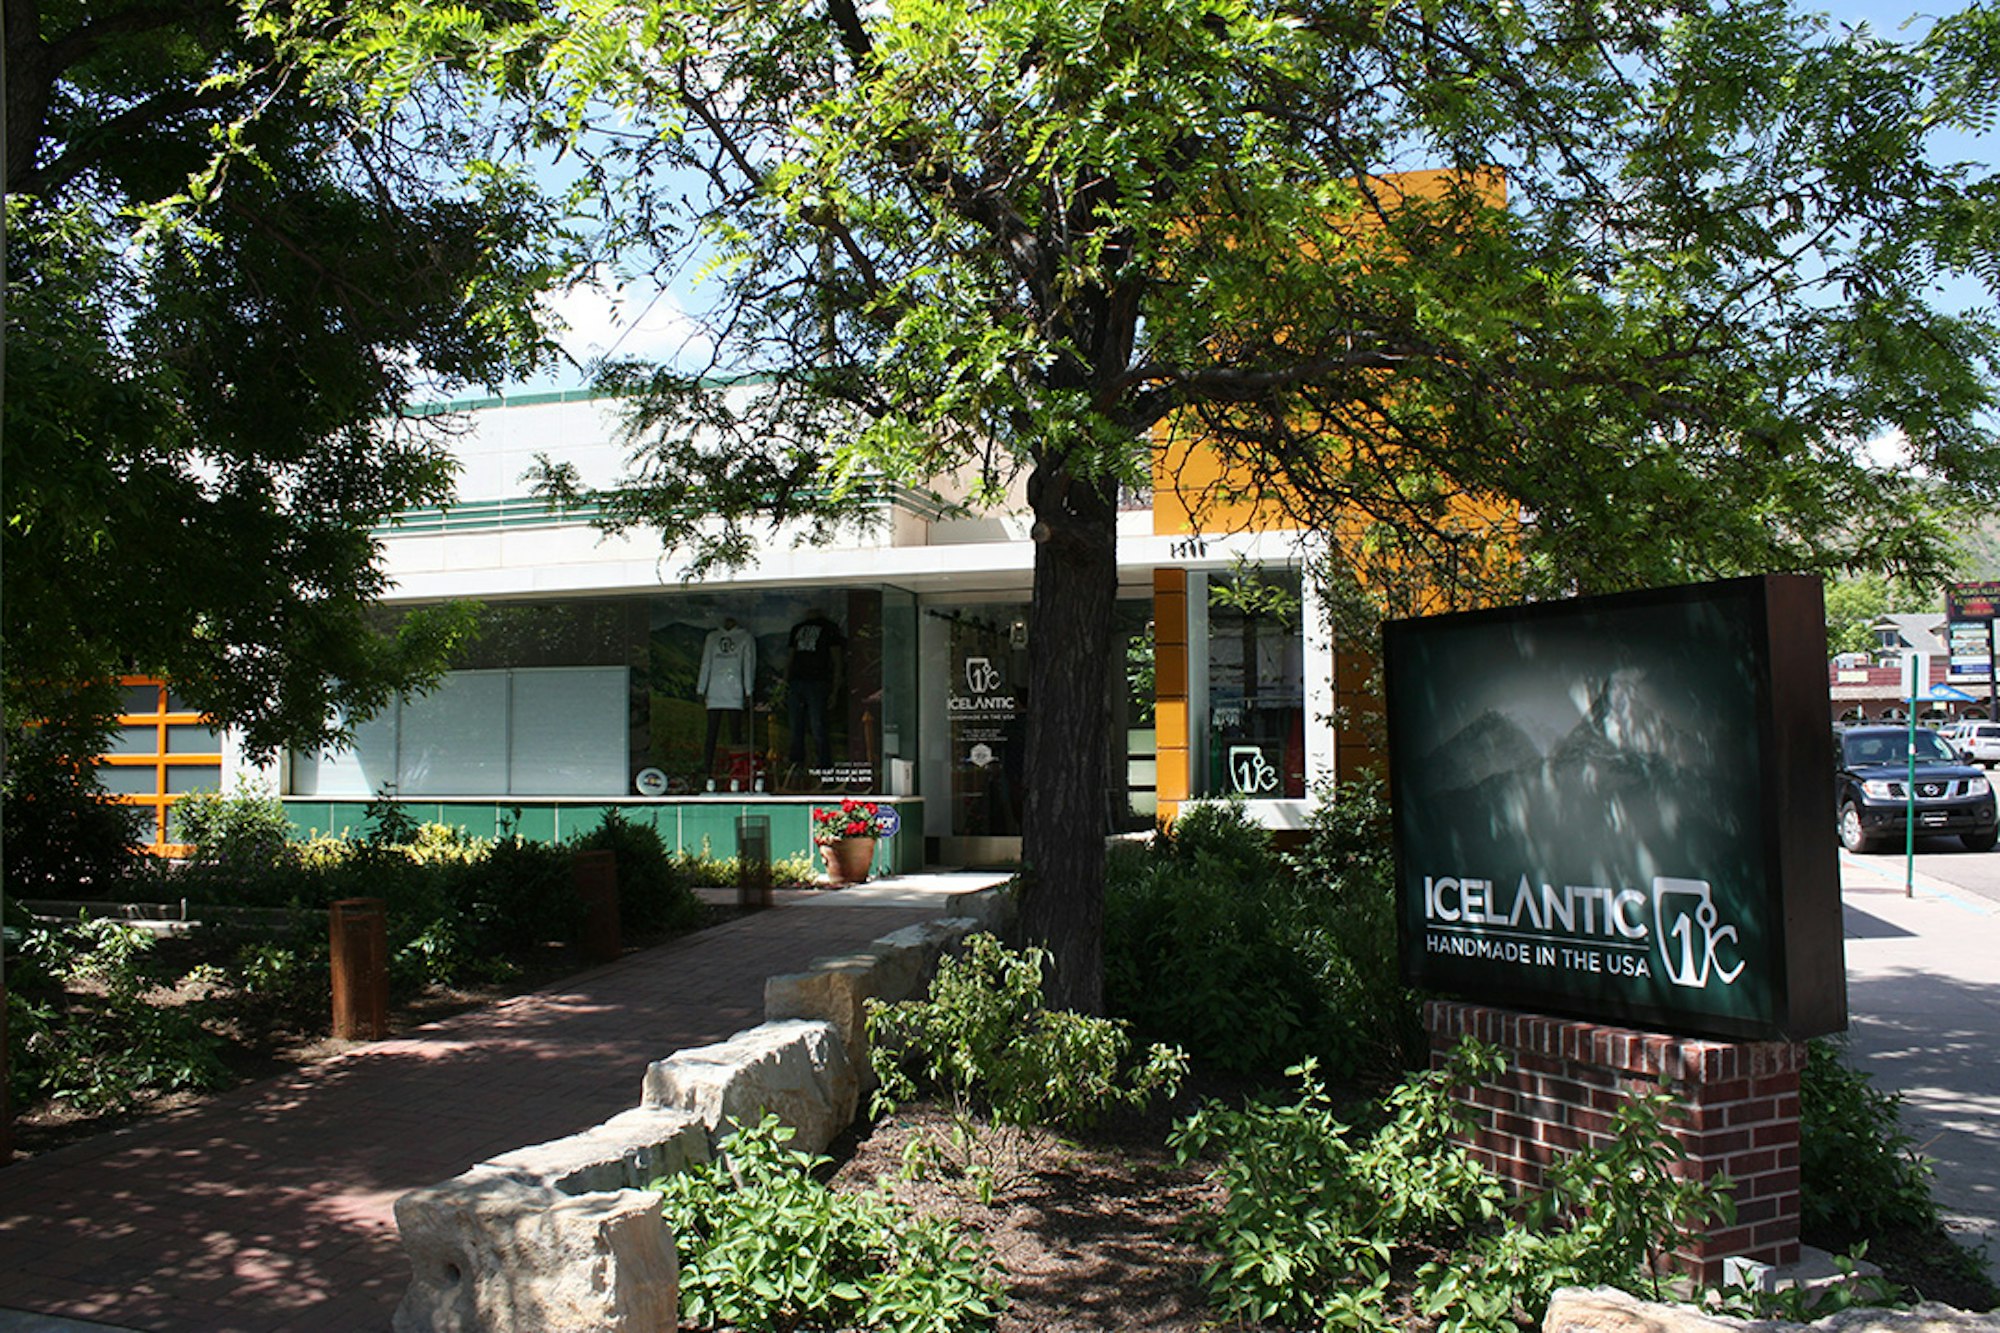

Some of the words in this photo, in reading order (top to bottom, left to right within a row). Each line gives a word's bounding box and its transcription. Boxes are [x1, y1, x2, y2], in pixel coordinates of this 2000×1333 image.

[947, 696, 1015, 710] ICELANTIC
[1424, 873, 1649, 940] ICELANTIC
[1426, 934, 1531, 964] HANDMADE
[1535, 946, 1556, 966] IN
[1562, 948, 1601, 973] THE
[1607, 953, 1651, 978] USA
